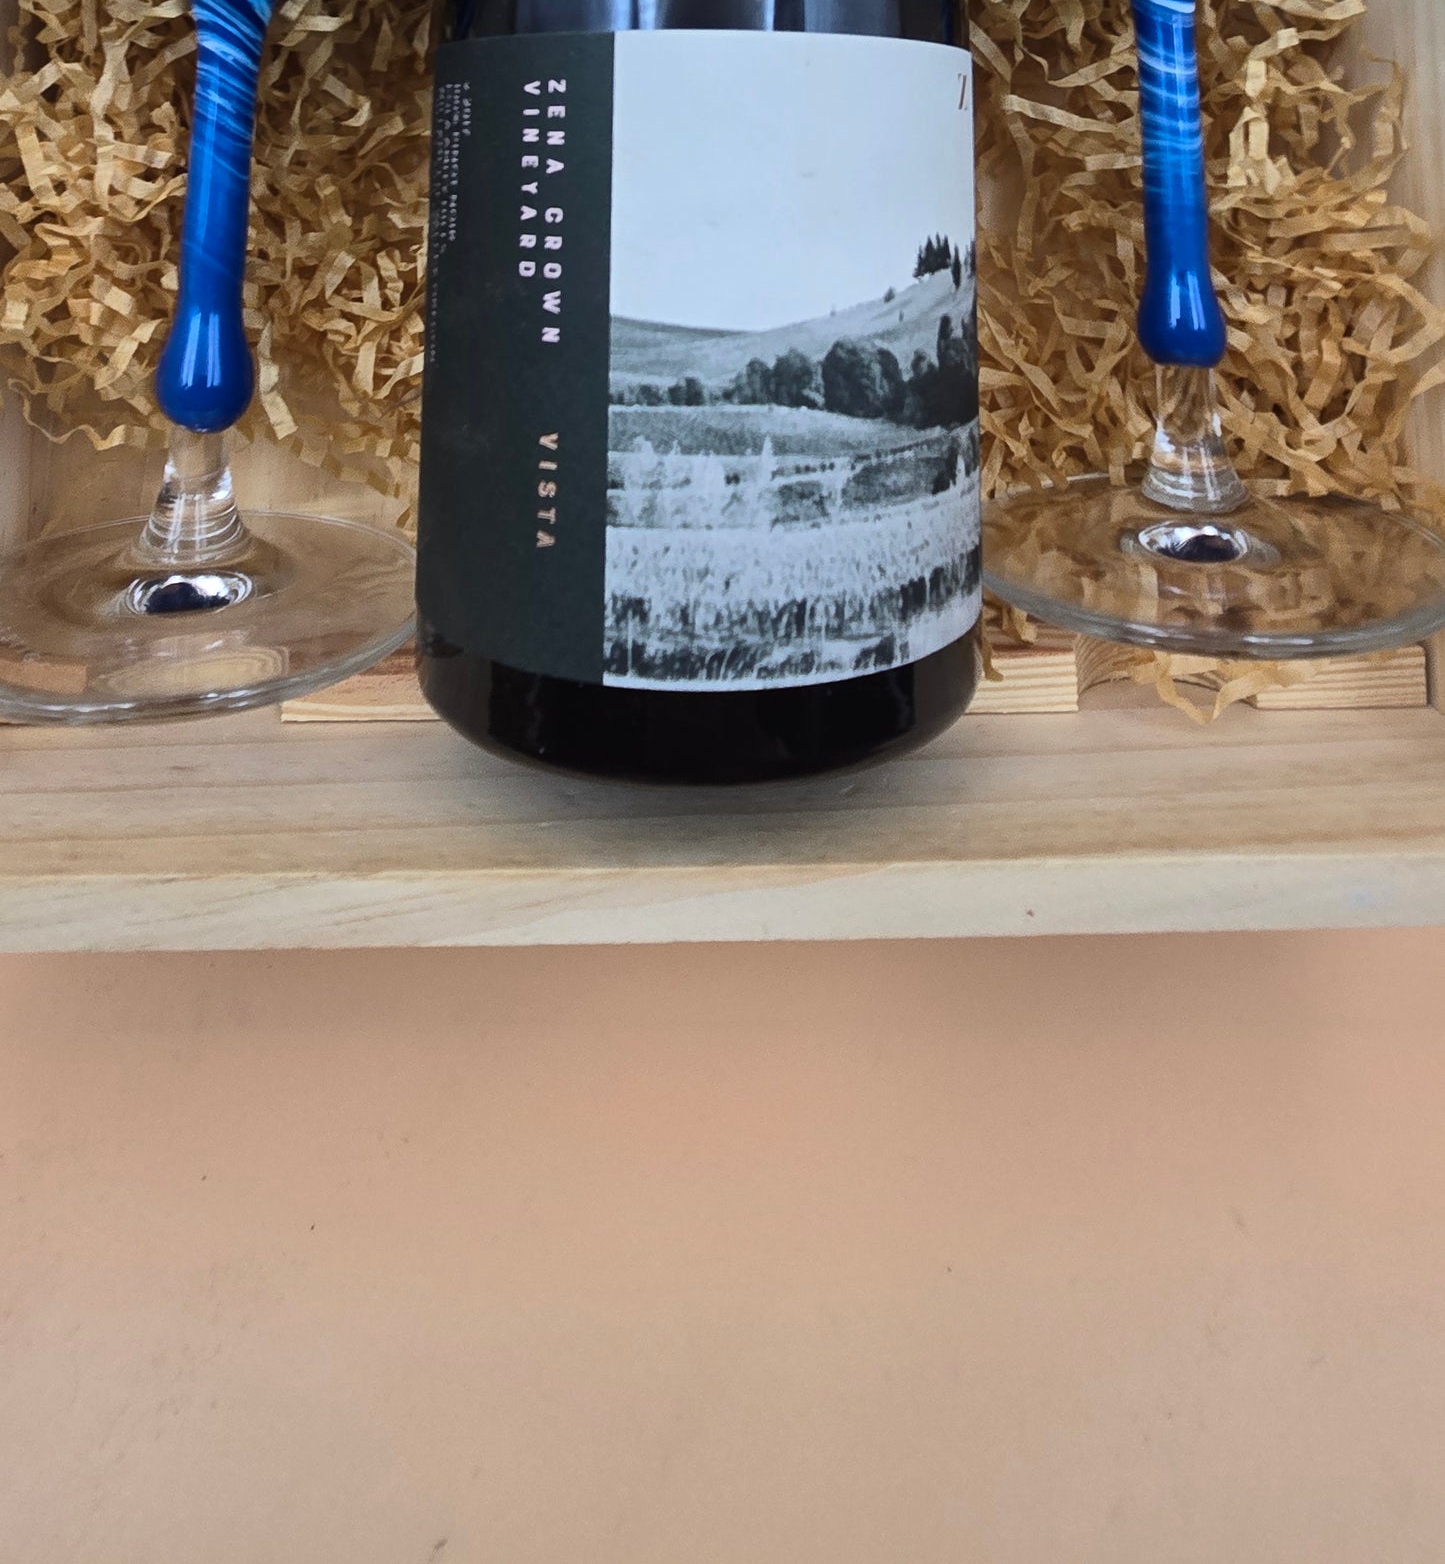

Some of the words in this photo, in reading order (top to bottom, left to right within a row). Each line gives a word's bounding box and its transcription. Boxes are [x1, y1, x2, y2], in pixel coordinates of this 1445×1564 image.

[518, 80, 541, 278] VINEYARD
[545, 79, 567, 174] ZENA
[541, 207, 564, 343] CROWN
[536, 432, 559, 549] VISTA
